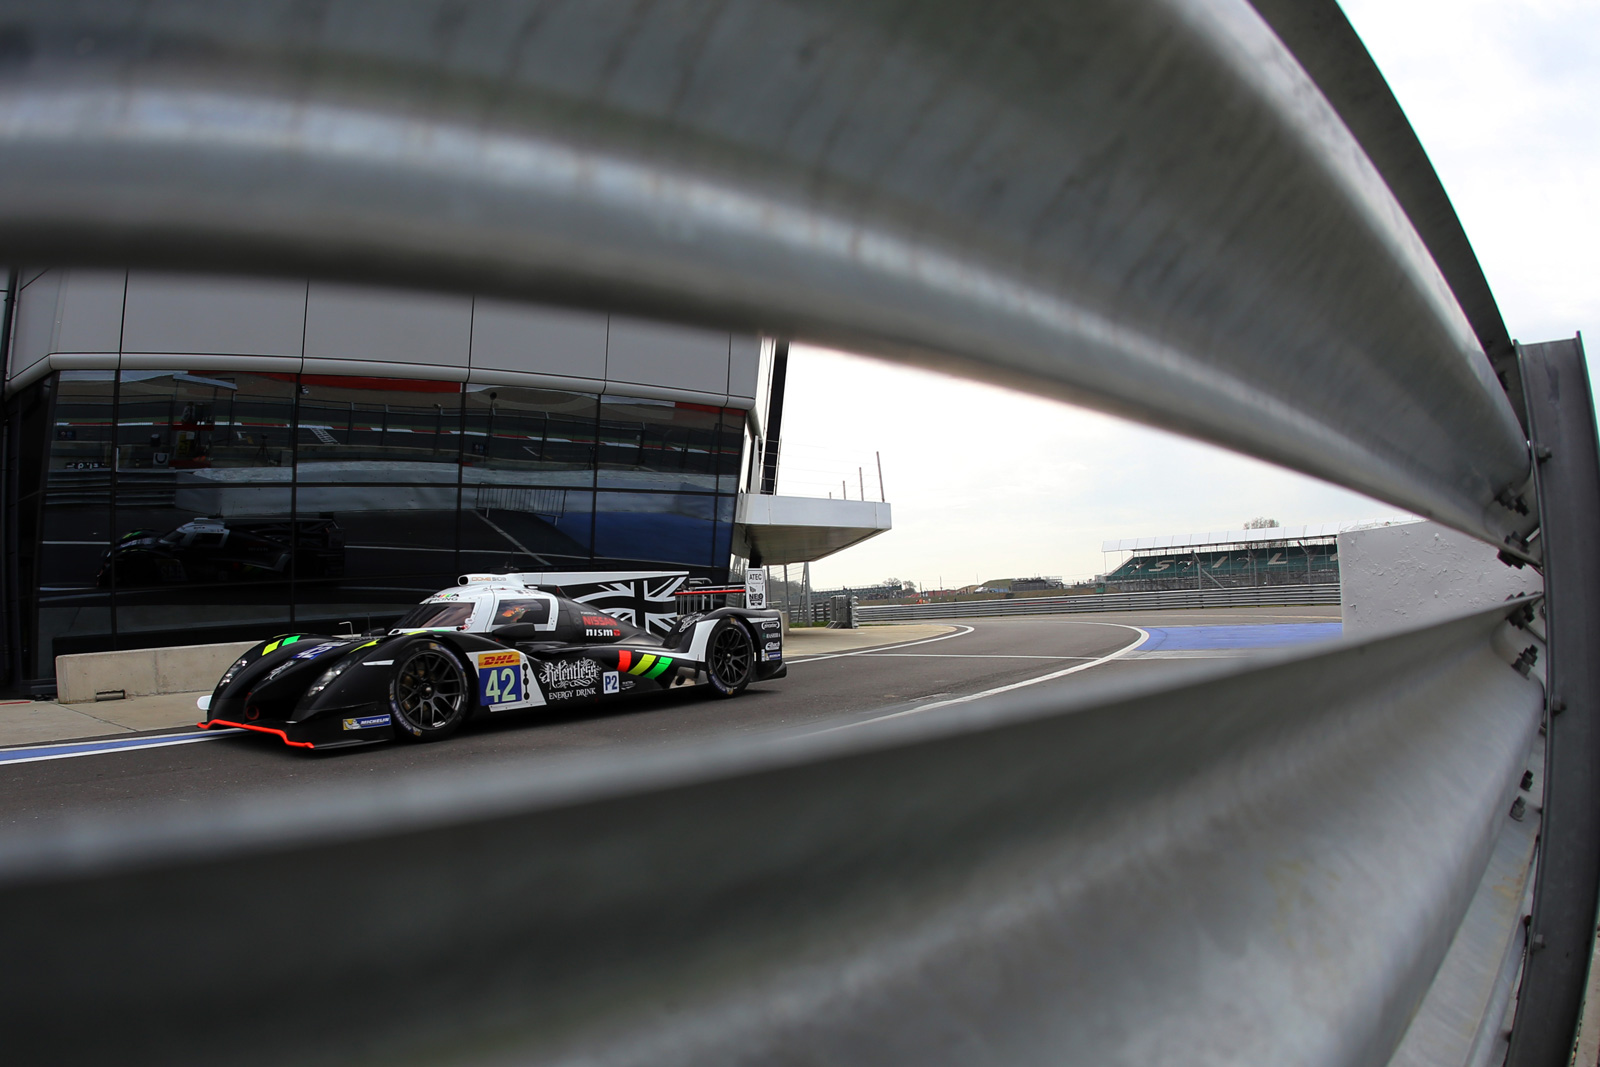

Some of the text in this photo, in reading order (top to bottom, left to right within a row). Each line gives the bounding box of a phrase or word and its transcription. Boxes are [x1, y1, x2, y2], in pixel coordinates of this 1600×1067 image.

[582, 616, 618, 626] NISSAN
[483, 654, 516, 665] DHL
[485, 667, 517, 703] 42
[604, 675, 619, 691] P2
[548, 687, 597, 700] ENERGY DRINK
[360, 717, 390, 725] MICHELIN
